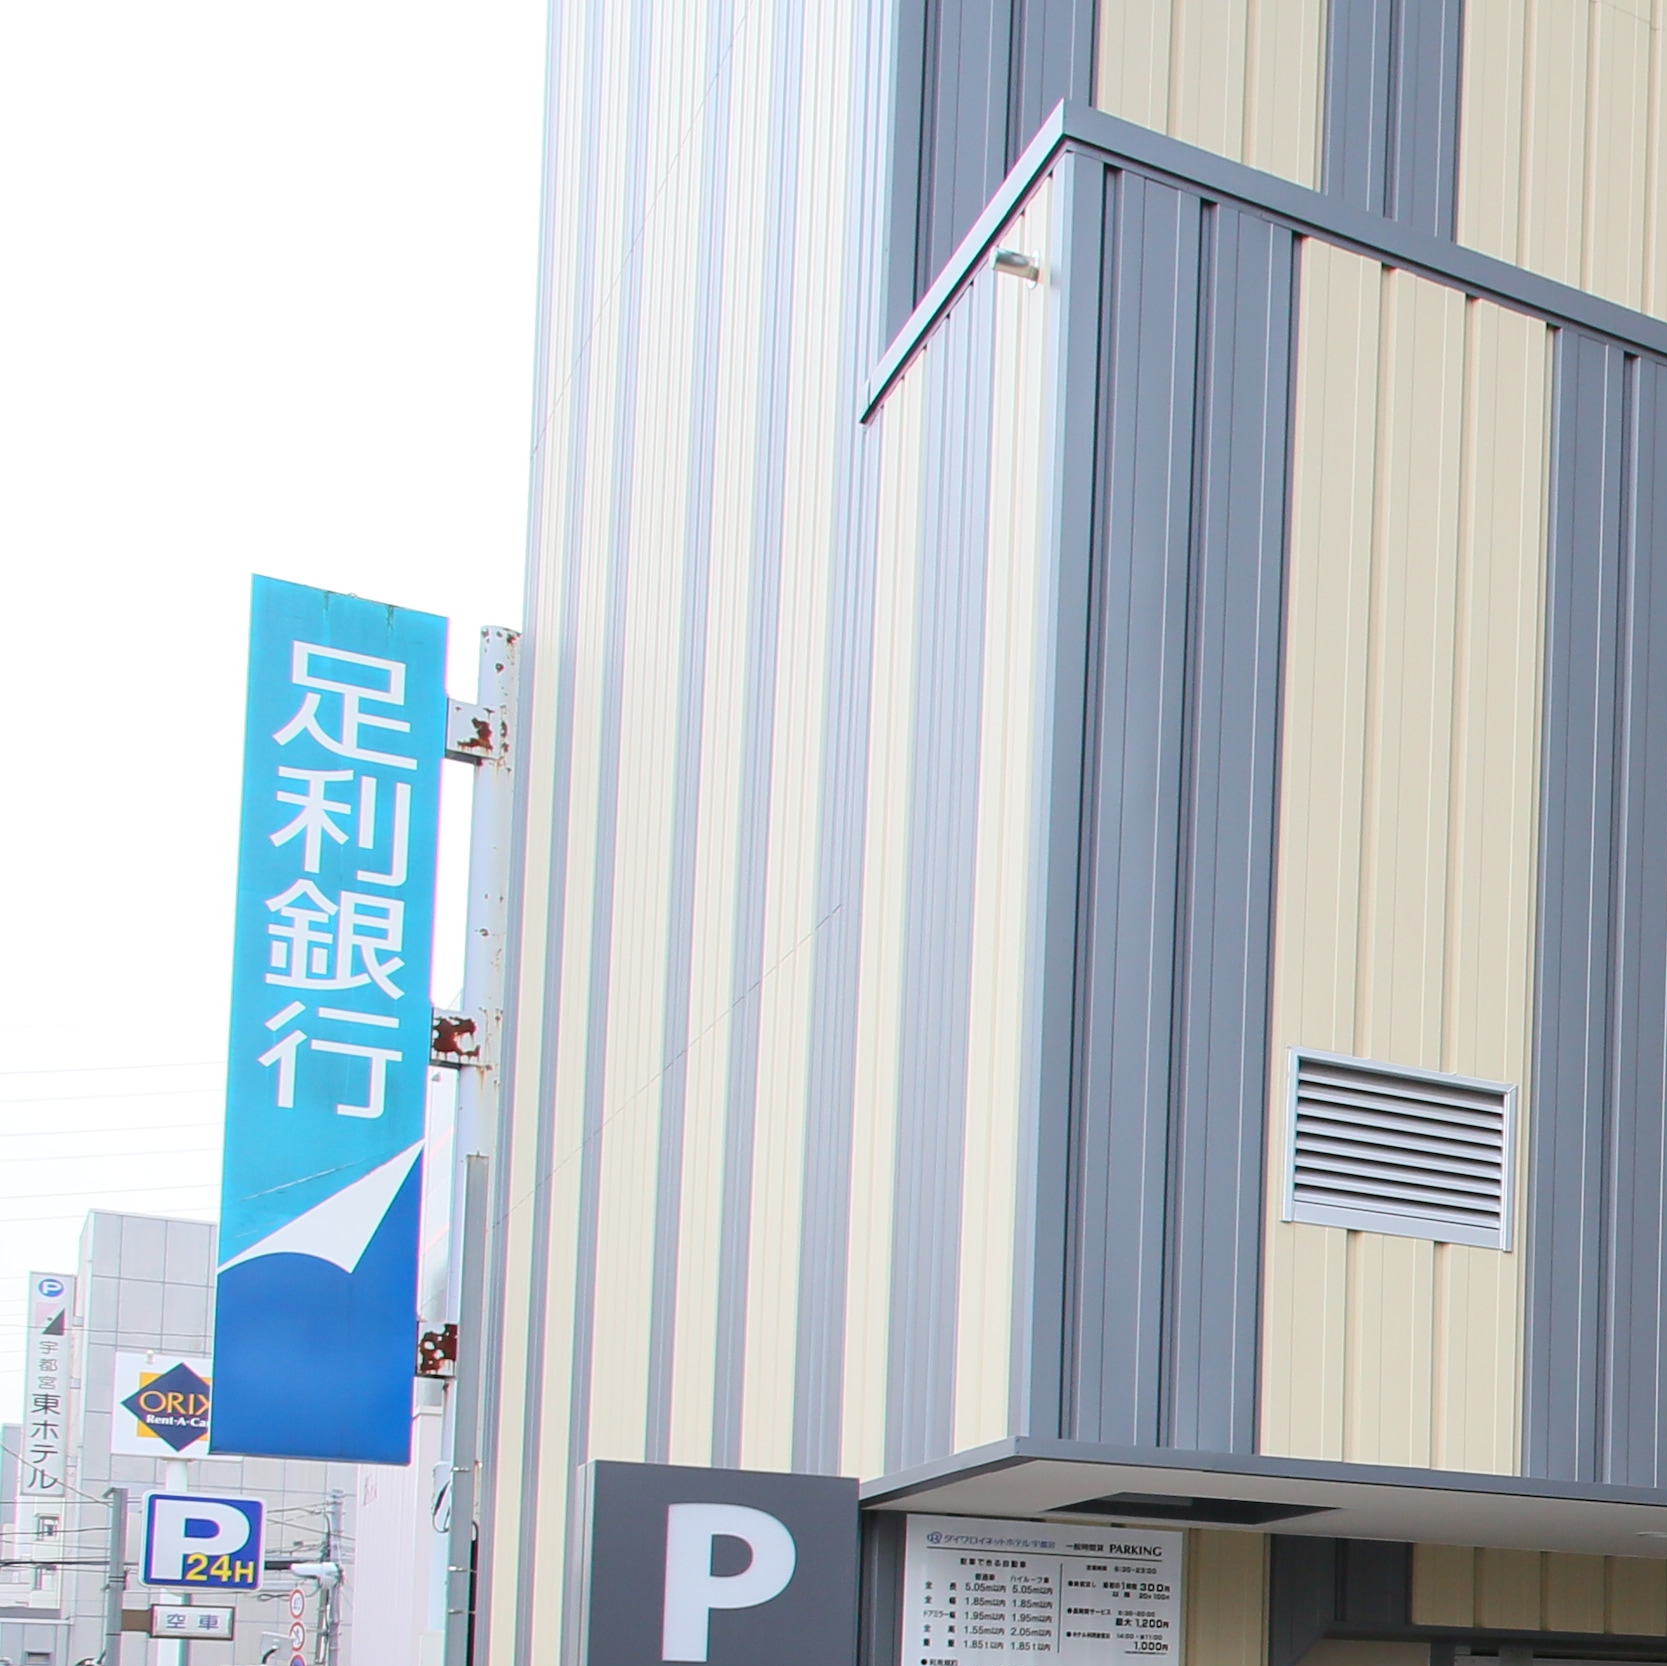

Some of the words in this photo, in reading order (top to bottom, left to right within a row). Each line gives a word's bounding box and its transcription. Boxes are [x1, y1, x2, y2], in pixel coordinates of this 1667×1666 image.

[258, 638, 418, 1121] 足利銀行
[42, 1281, 62, 1295] P
[146, 1414, 209, 1428] Rent-A-Ca
[150, 1498, 250, 1580] P
[1109, 1543, 1162, 1557] PARKING
[185, 1553, 254, 1584] 24H
[660, 1501, 798, 1663] P
[166, 1613, 220, 1631] 空車
